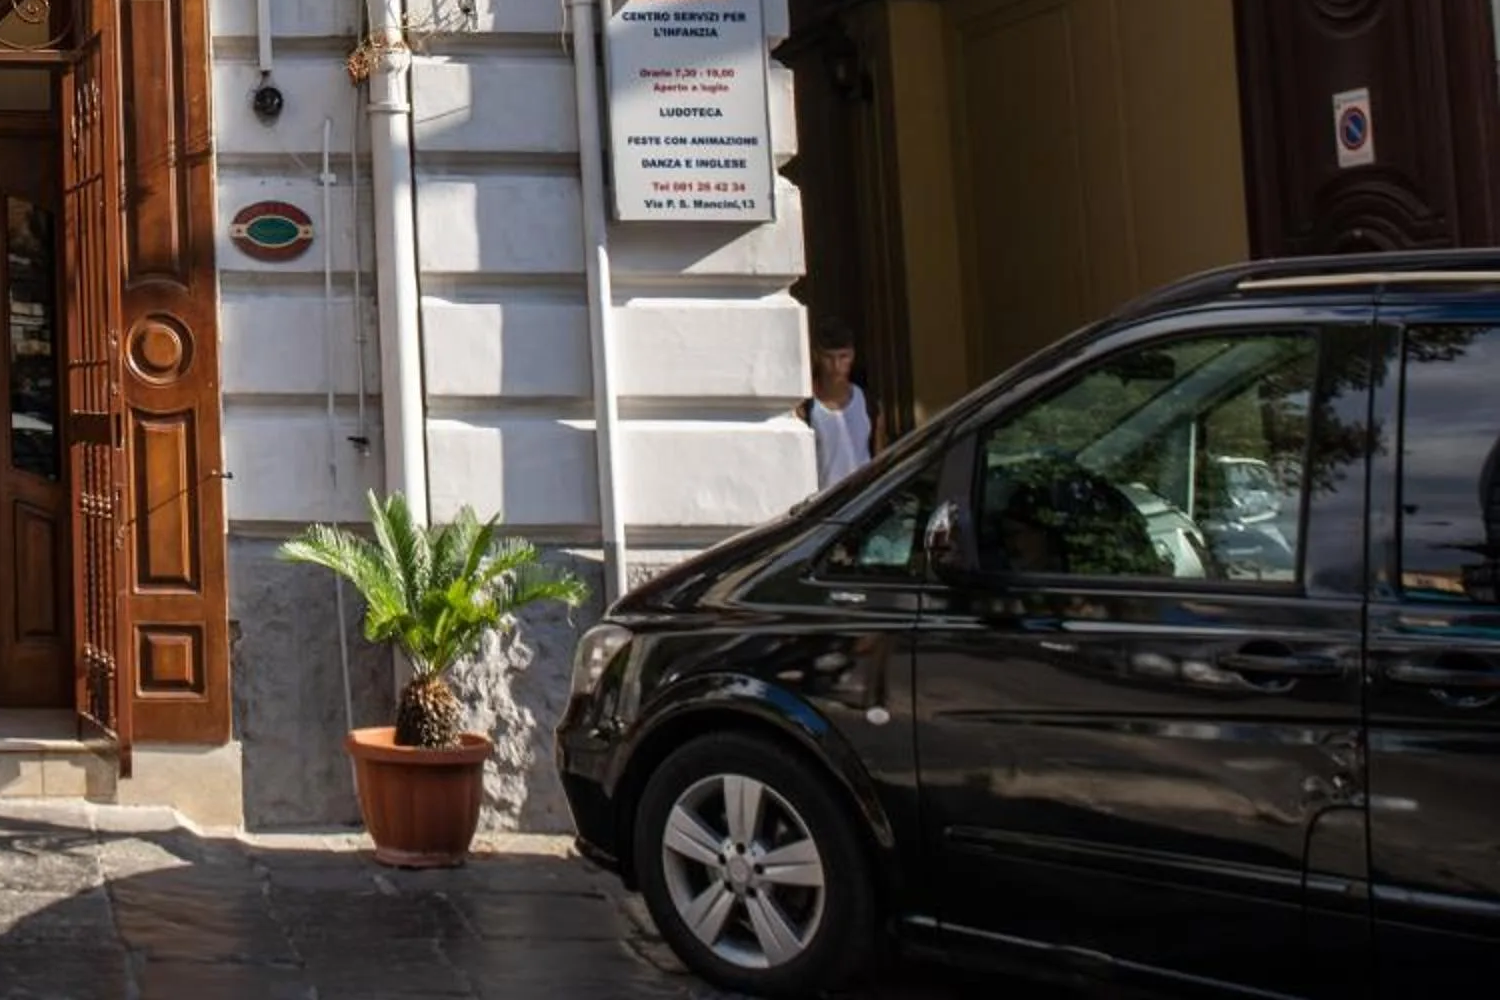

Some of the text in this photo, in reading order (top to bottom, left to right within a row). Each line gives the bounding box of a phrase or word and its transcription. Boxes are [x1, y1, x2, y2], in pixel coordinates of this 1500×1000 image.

[622, 11, 747, 22] CENTRO SERVIZI PER
[653, 27, 719, 38] L'INFANZIA
[653, 83, 689, 94] Aperto
[659, 107, 723, 117] LUDOTECA
[627, 136, 759, 146] FESTE CON ANIMAZIONE
[641, 158, 747, 169] DANZA E INGLESE
[652, 181, 670, 192] Tel
[643, 199, 663, 209] Via
